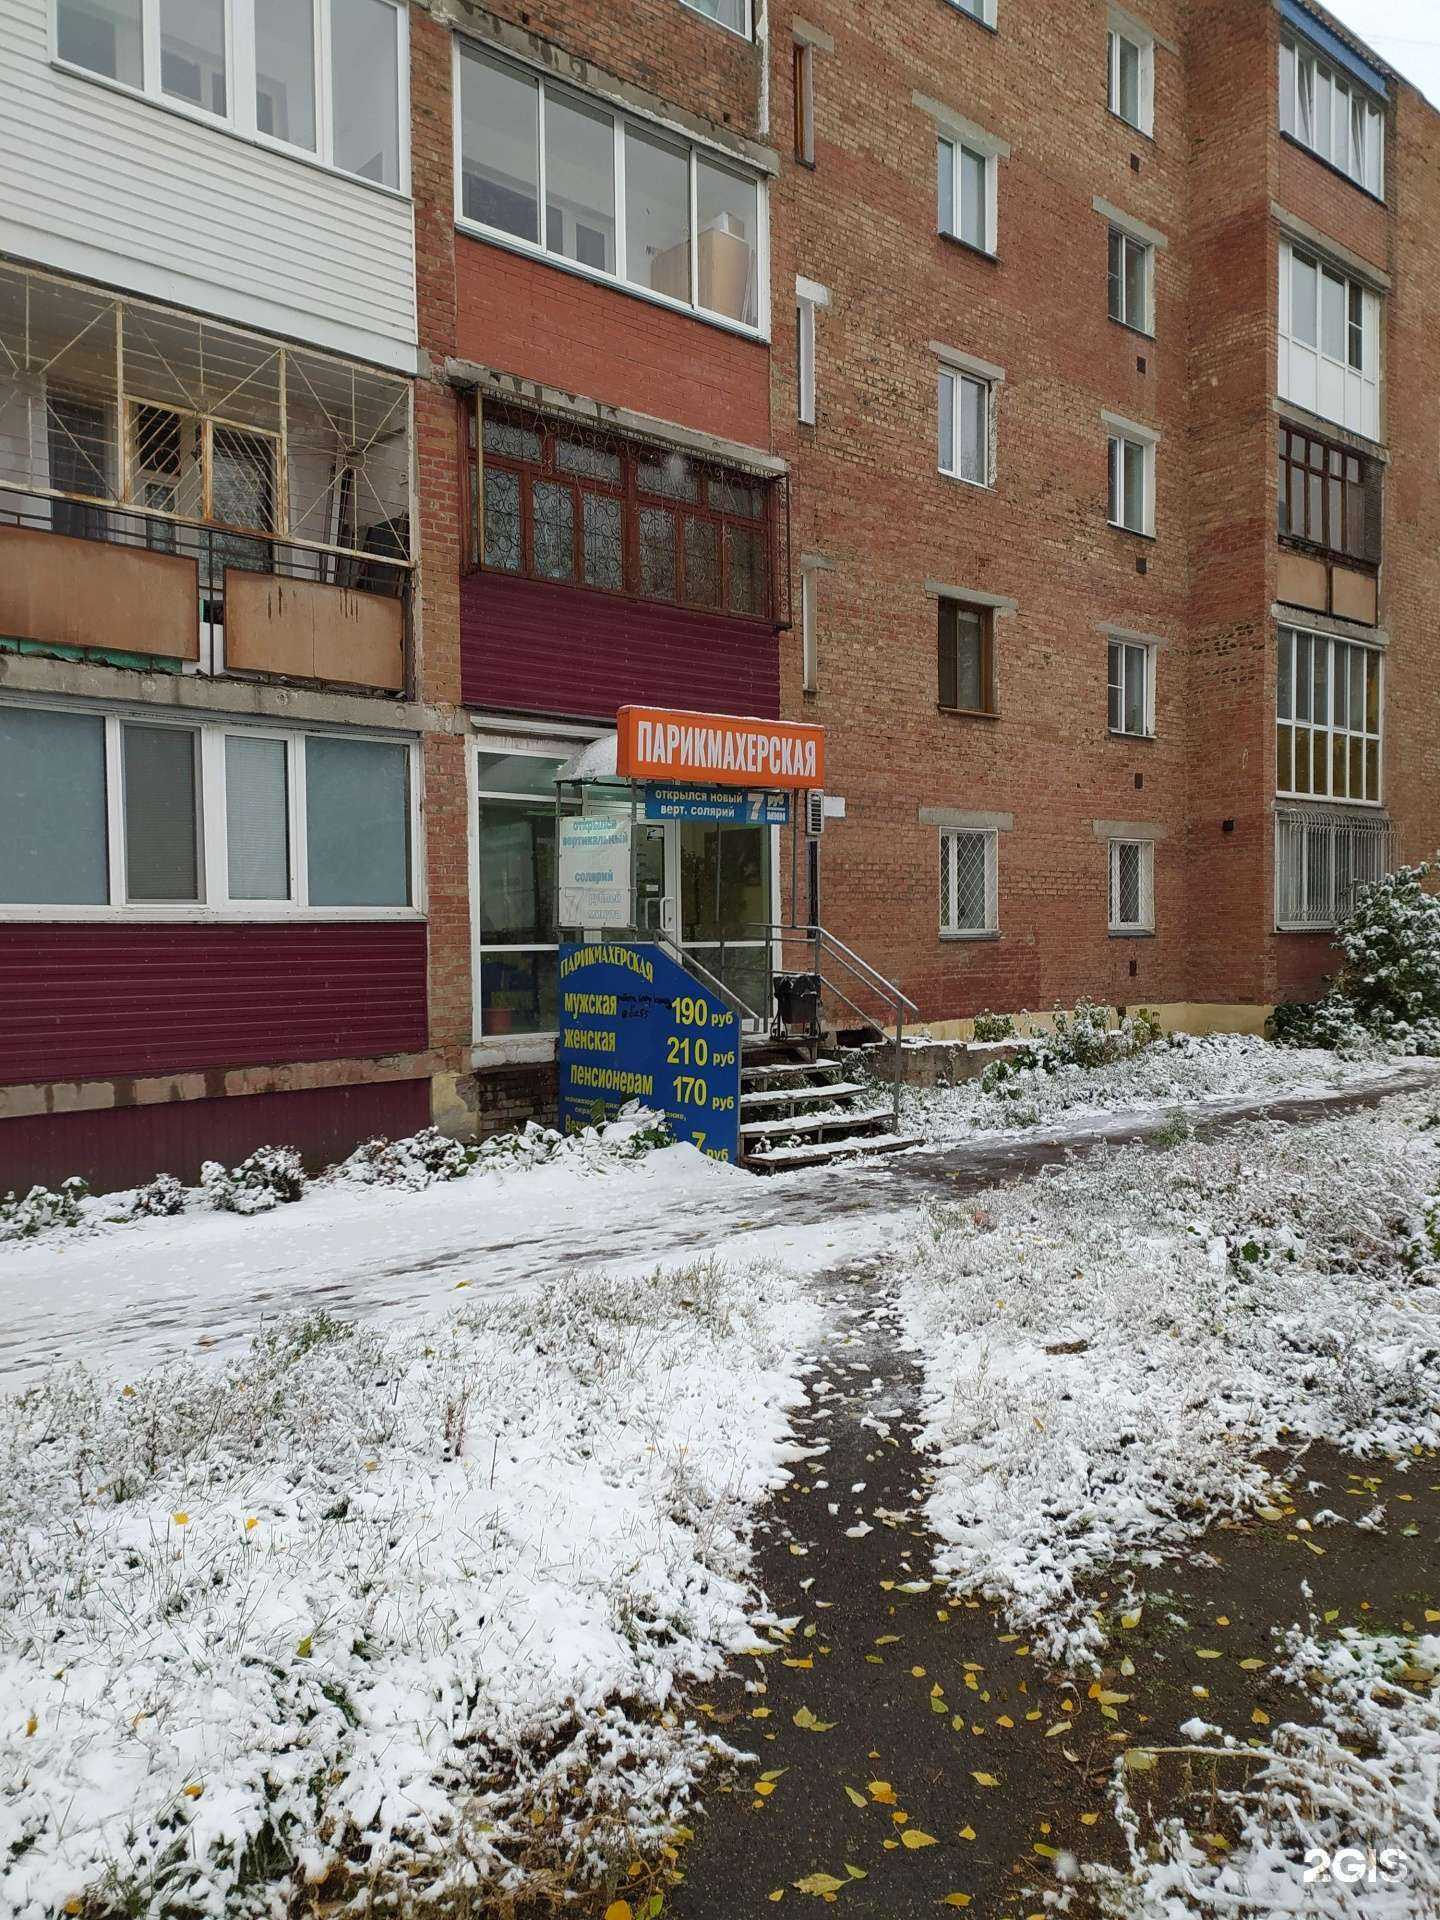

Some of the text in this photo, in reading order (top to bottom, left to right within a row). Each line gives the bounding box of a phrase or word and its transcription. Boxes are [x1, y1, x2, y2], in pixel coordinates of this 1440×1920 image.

[637, 720, 816, 777] ПАРИКМАХЕРСКАЯ
[655, 789, 743, 803] открылся новый
[660, 804, 735, 819] верт. солярий
[747, 793, 764, 822] 7
[575, 869, 614, 885] солярий
[560, 944, 654, 984] ПАРИКМАХЕРСКАЯ
[564, 992, 618, 1020] мужская
[671, 996, 708, 1028] 190
[711, 1011, 733, 1028] руб
[564, 1027, 735, 1067] женская 210 руб
[570, 1063, 734, 1112] пенсионерам 170 руб
